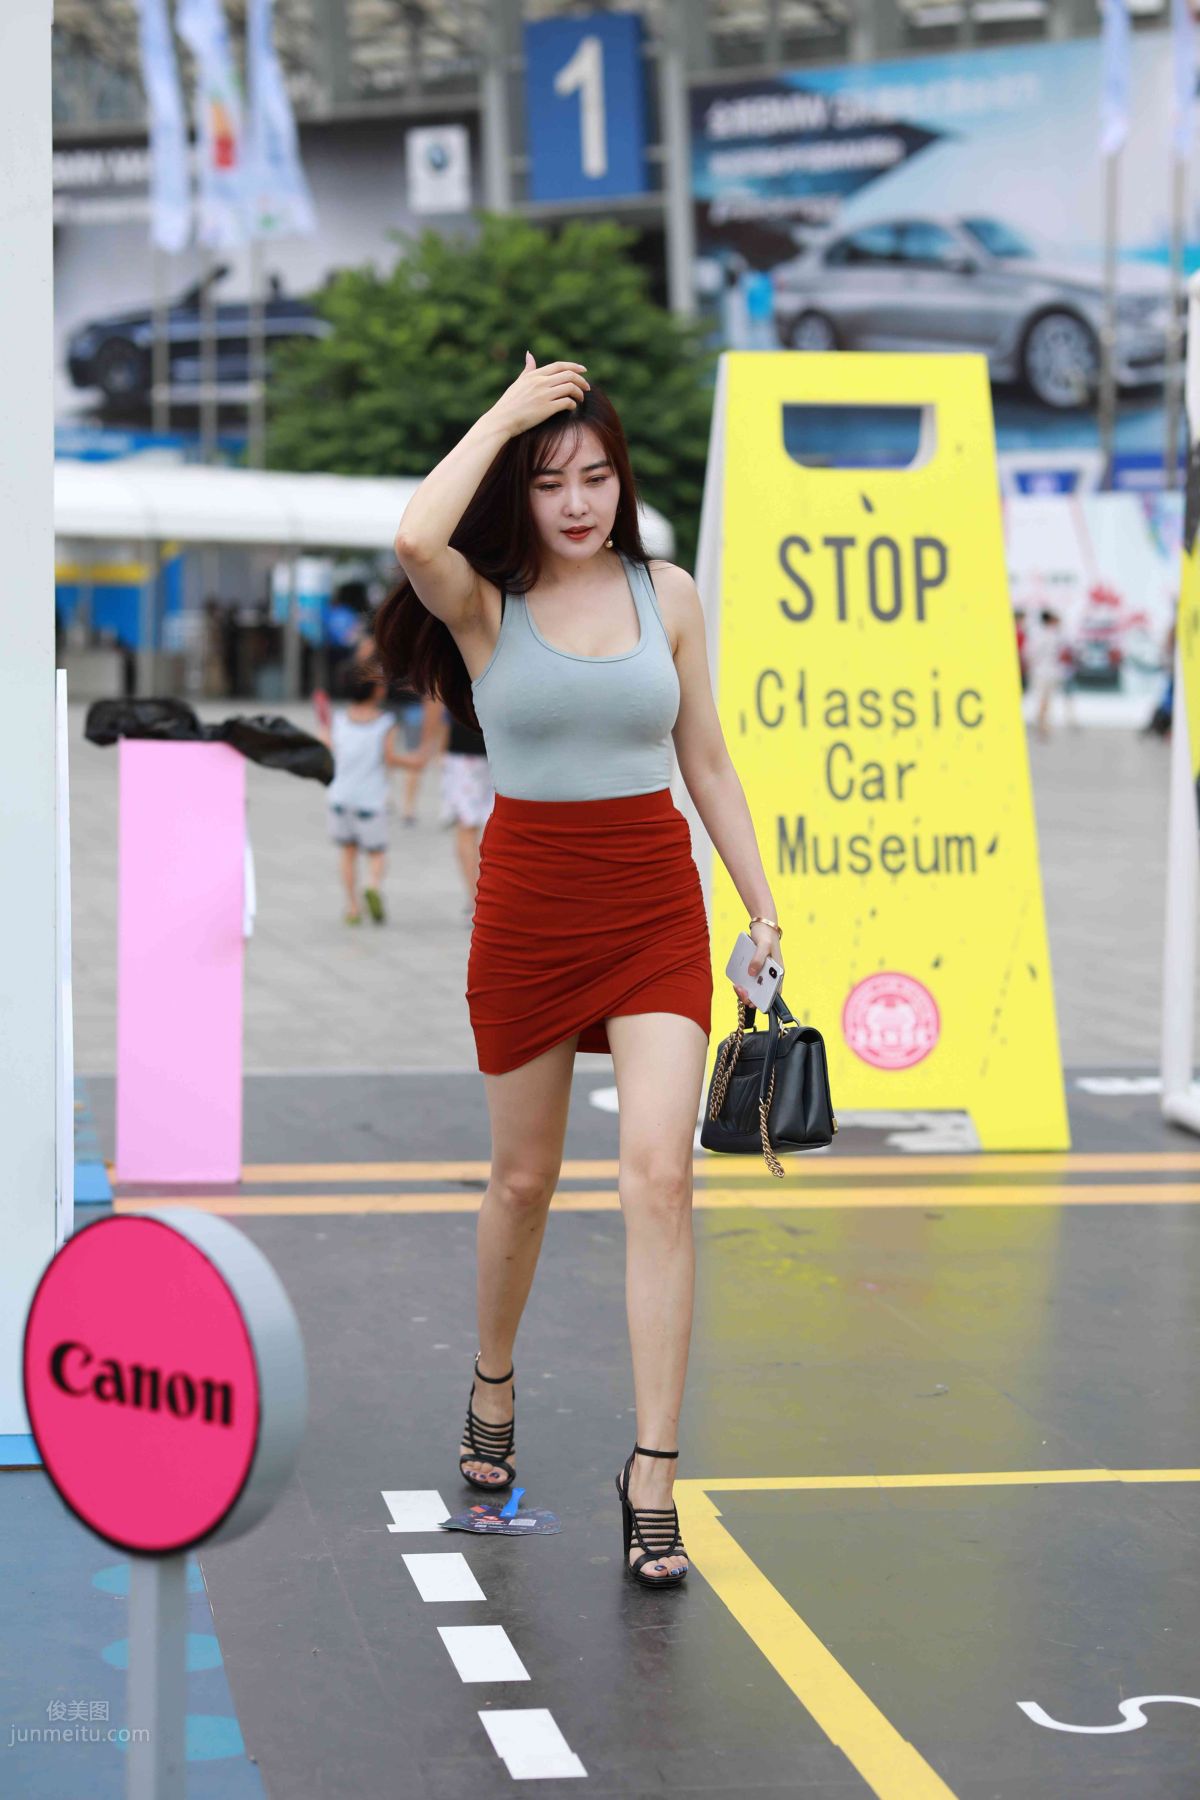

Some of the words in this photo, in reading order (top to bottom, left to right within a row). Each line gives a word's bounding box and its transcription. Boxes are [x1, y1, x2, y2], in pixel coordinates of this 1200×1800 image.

[554, 35, 608, 178] 1
[778, 535, 948, 622] STOP
[755, 668, 984, 729] Classic
[825, 742, 916, 802] Car
[776, 815, 977, 876] Museum
[49, 1340, 235, 1428] Canon
